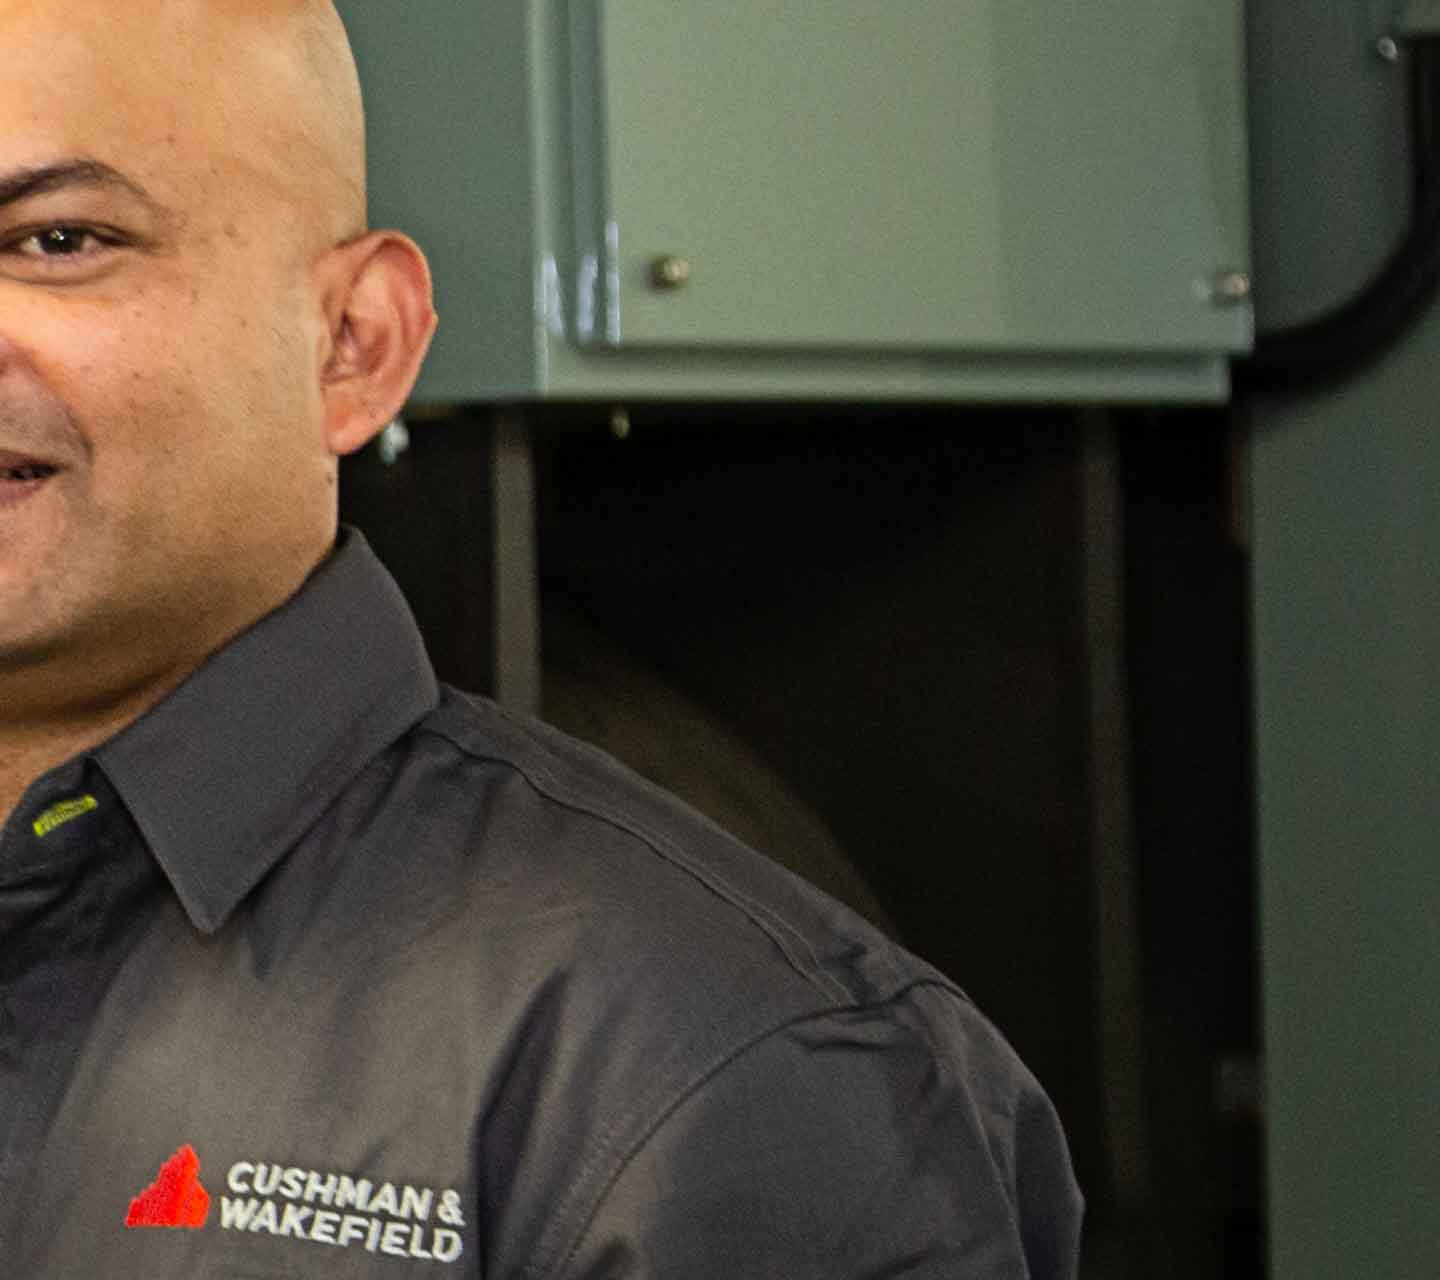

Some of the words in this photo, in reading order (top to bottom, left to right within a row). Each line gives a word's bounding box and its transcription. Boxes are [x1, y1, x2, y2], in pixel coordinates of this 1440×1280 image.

[226, 1161, 434, 1222] CUSHMAN
[436, 1188, 466, 1226] &
[220, 1196, 464, 1263] WAKEFIELD
